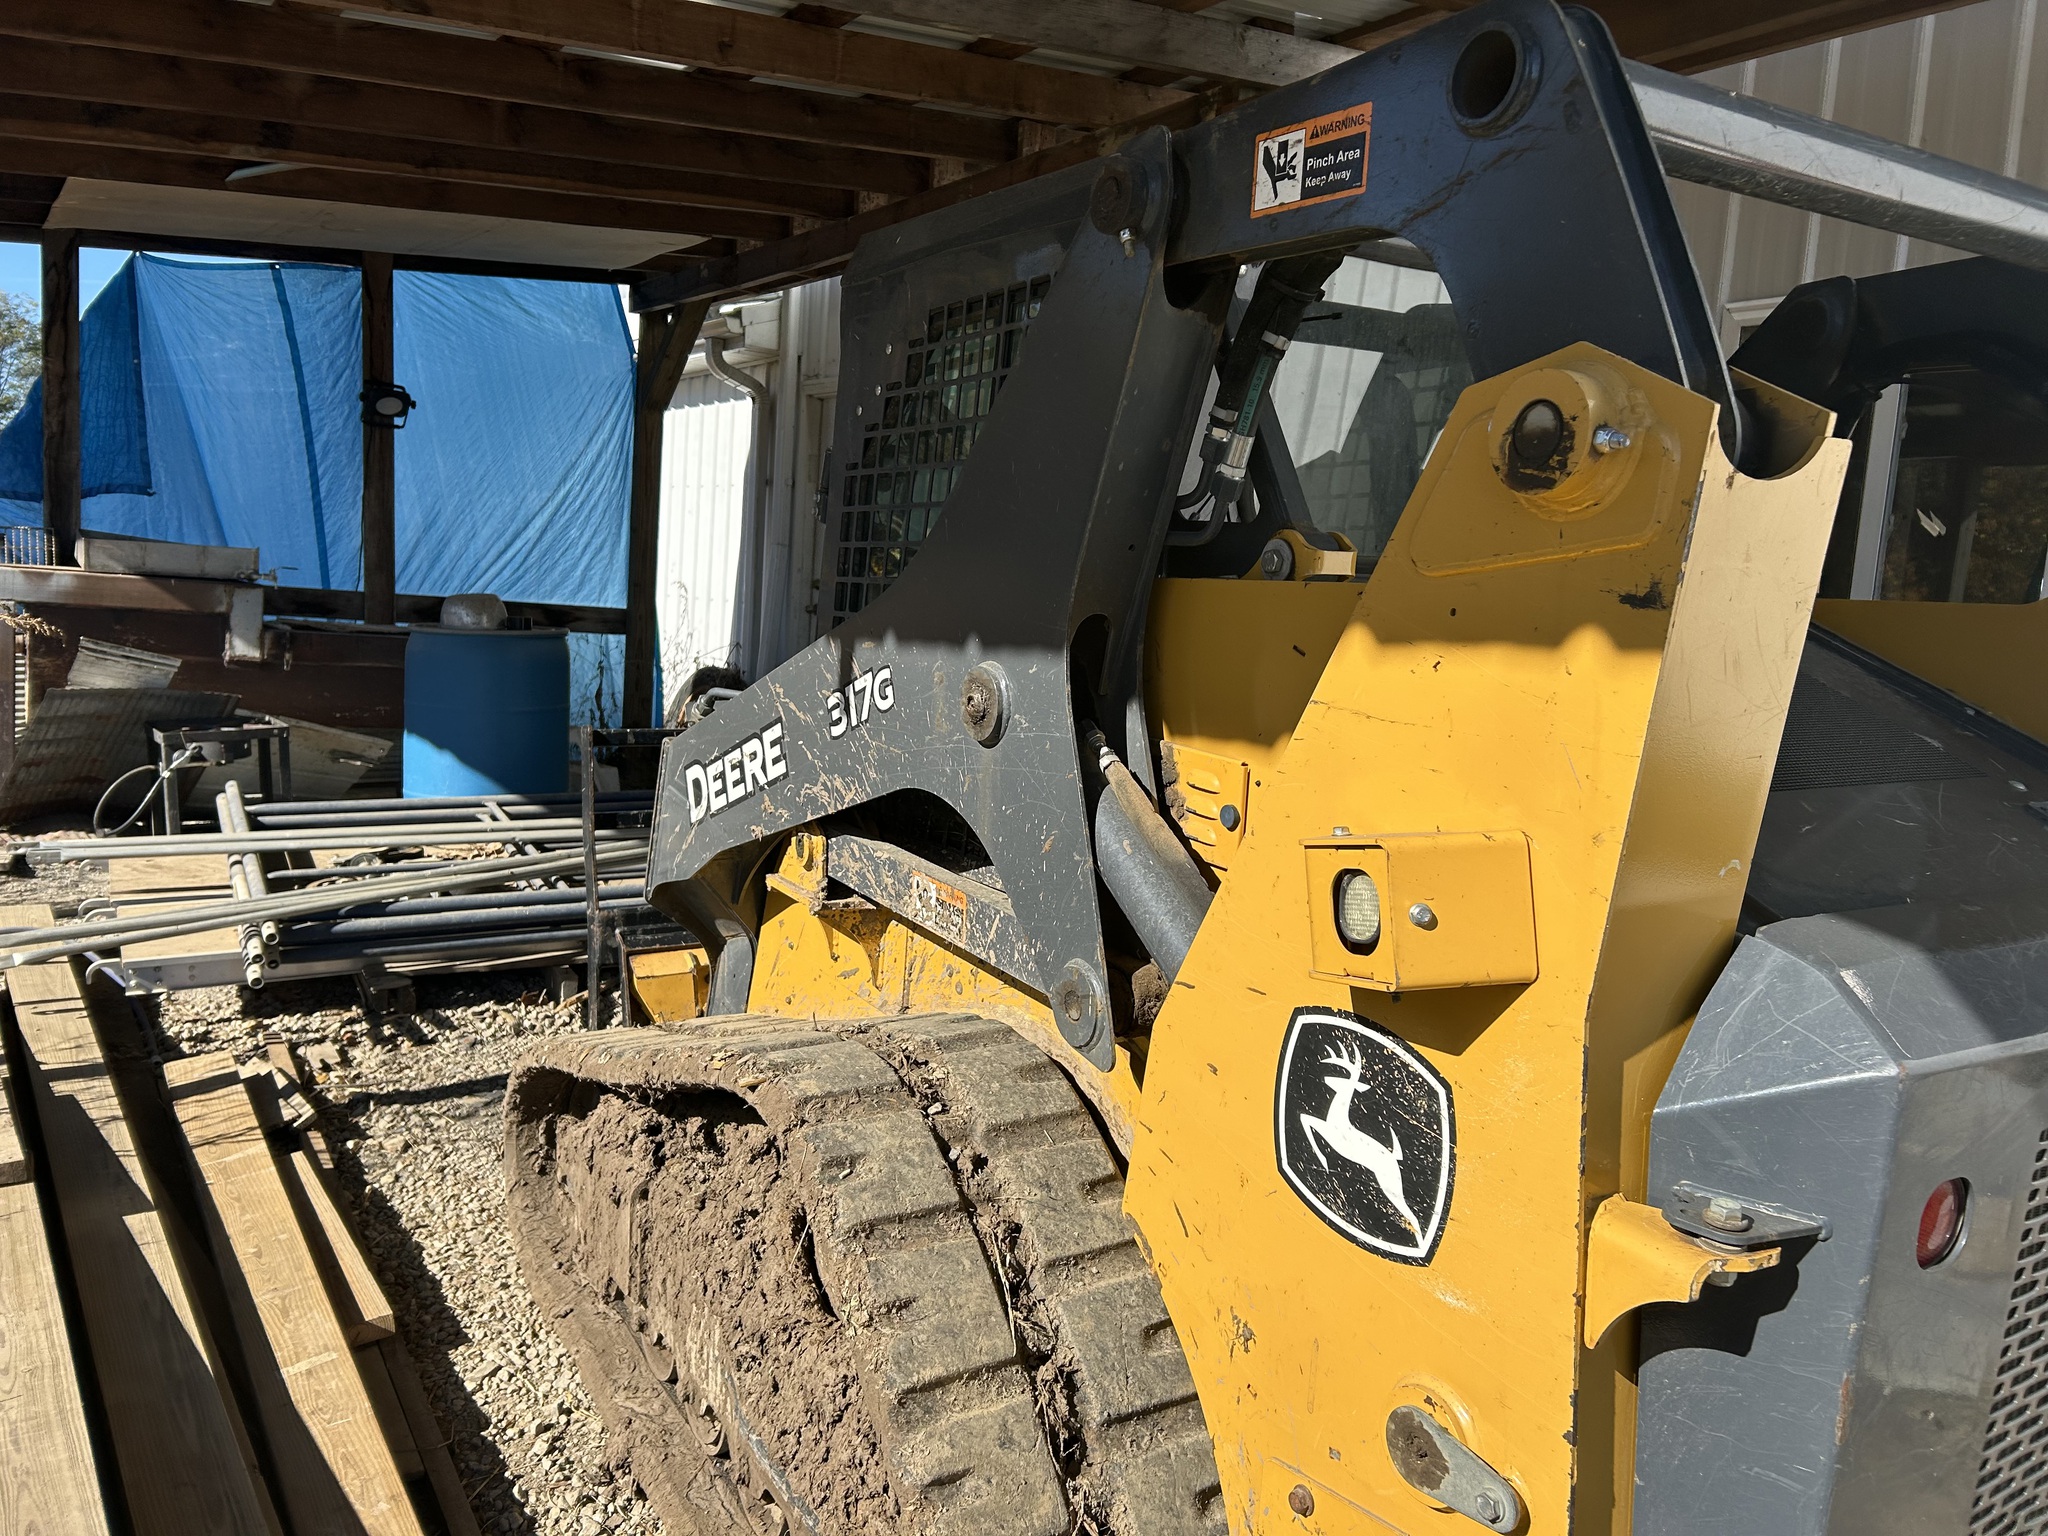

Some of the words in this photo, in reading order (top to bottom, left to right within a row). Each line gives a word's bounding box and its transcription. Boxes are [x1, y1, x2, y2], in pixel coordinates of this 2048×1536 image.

[1320, 113, 1365, 136] WARNING
[1306, 153, 1334, 171] Pinch
[1336, 148, 1360, 163] Area
[1305, 175, 1327, 188] Keep
[1328, 169, 1351, 182] Away
[686, 721, 787, 825] DEERE
[827, 666, 895, 738] 317G
